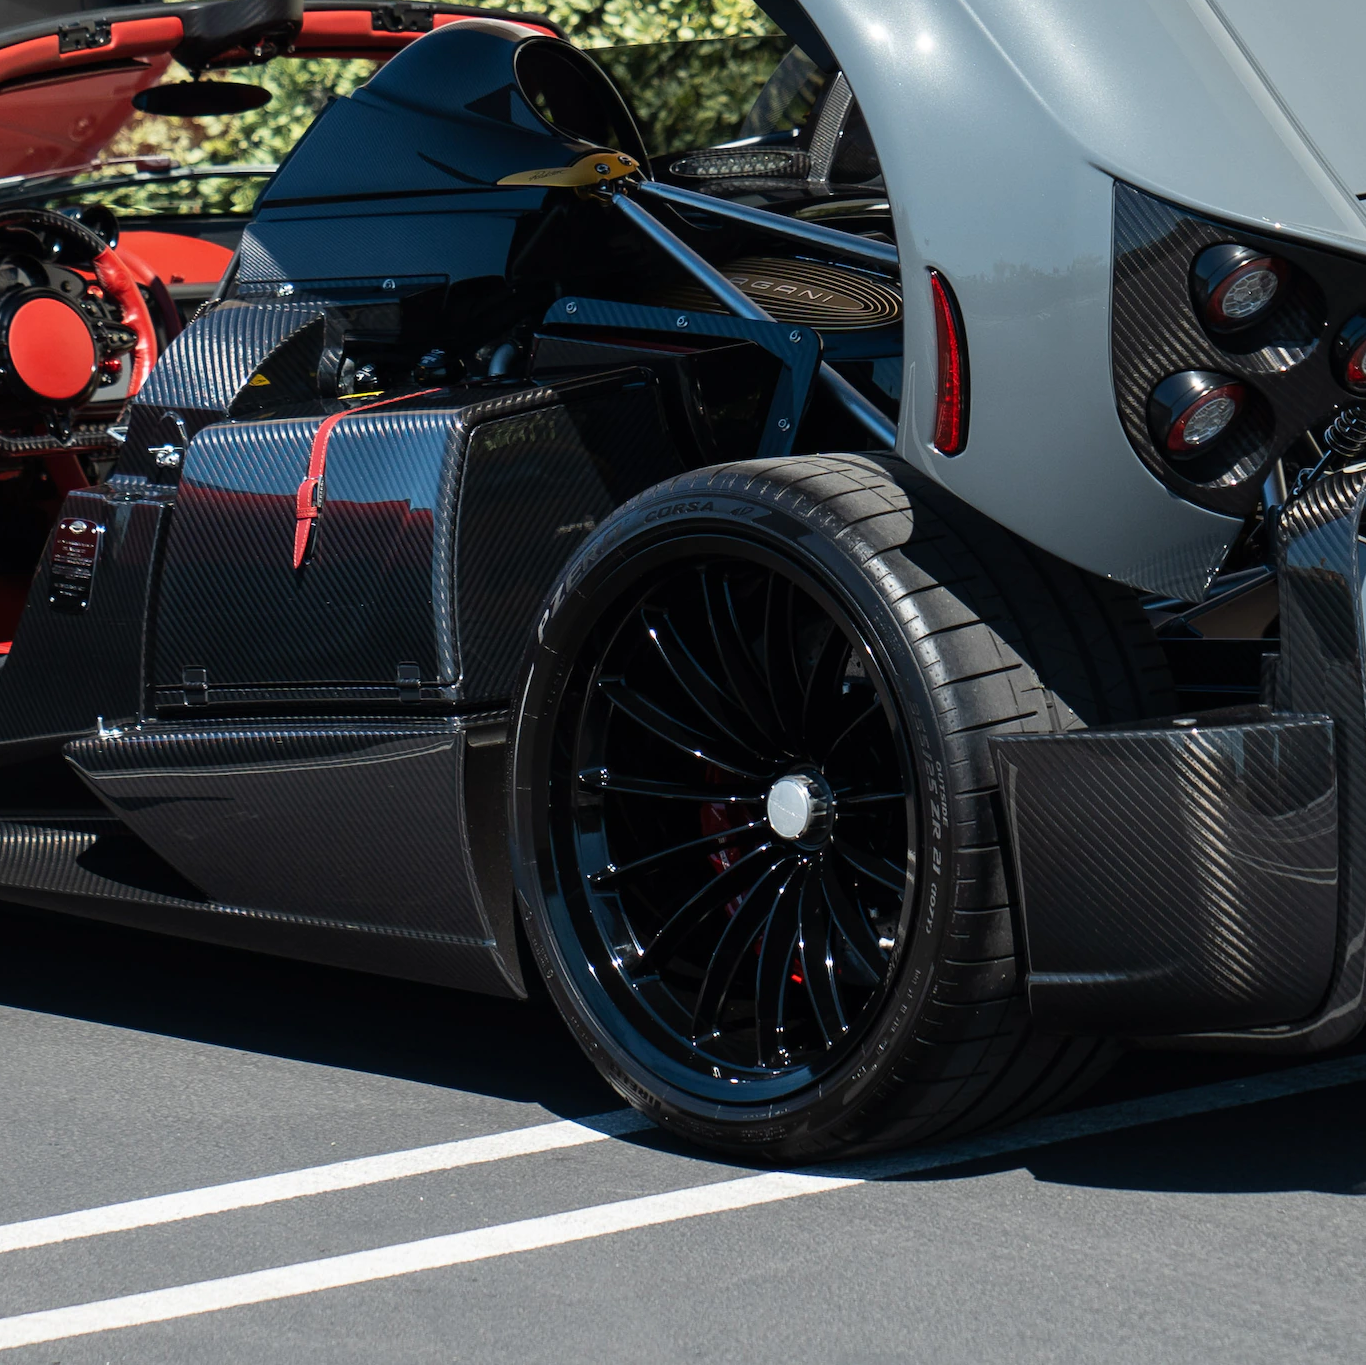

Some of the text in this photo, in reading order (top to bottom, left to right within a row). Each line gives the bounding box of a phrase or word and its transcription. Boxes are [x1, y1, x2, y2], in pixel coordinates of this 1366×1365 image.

[728, 277, 834, 303] AGANI
[643, 501, 715, 523] CORSA
[935, 760, 949, 829] OUTSIDE
[929, 799, 942, 840] ZR
[931, 846, 942, 876] 21
